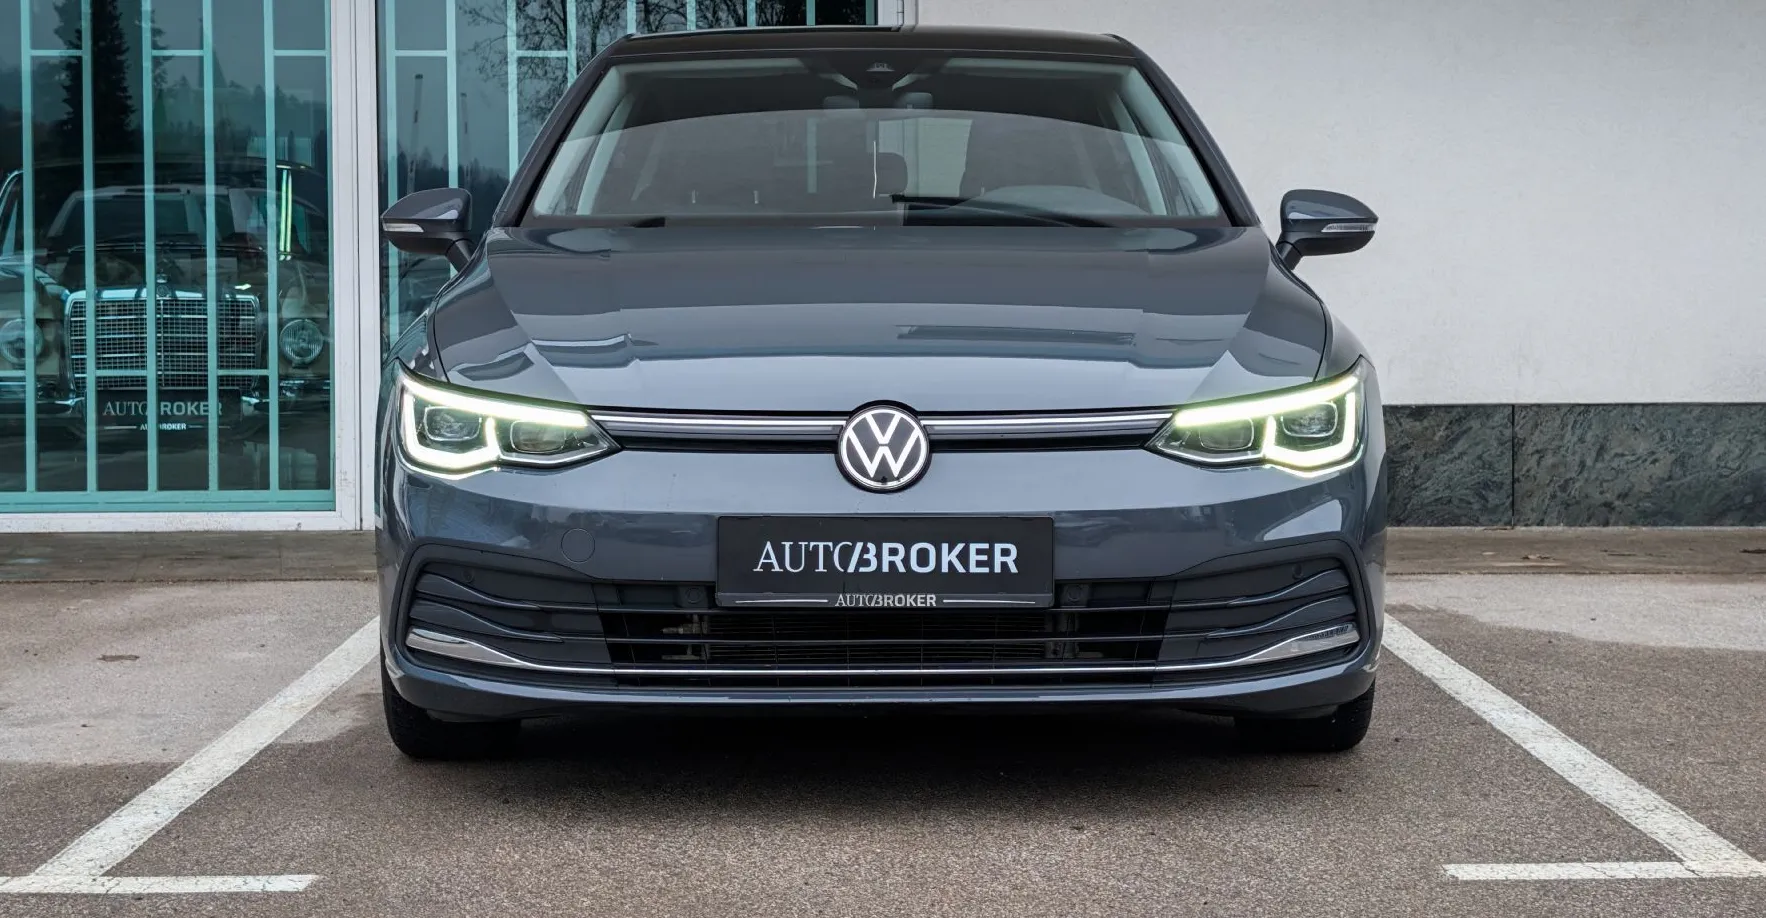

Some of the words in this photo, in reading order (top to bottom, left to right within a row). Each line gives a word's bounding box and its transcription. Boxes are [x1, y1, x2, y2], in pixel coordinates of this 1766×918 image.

[102, 401, 223, 416] AUTOROKE
[752, 540, 1019, 573] AUTOBROKER
[834, 593, 937, 607] AUTOBROKER
